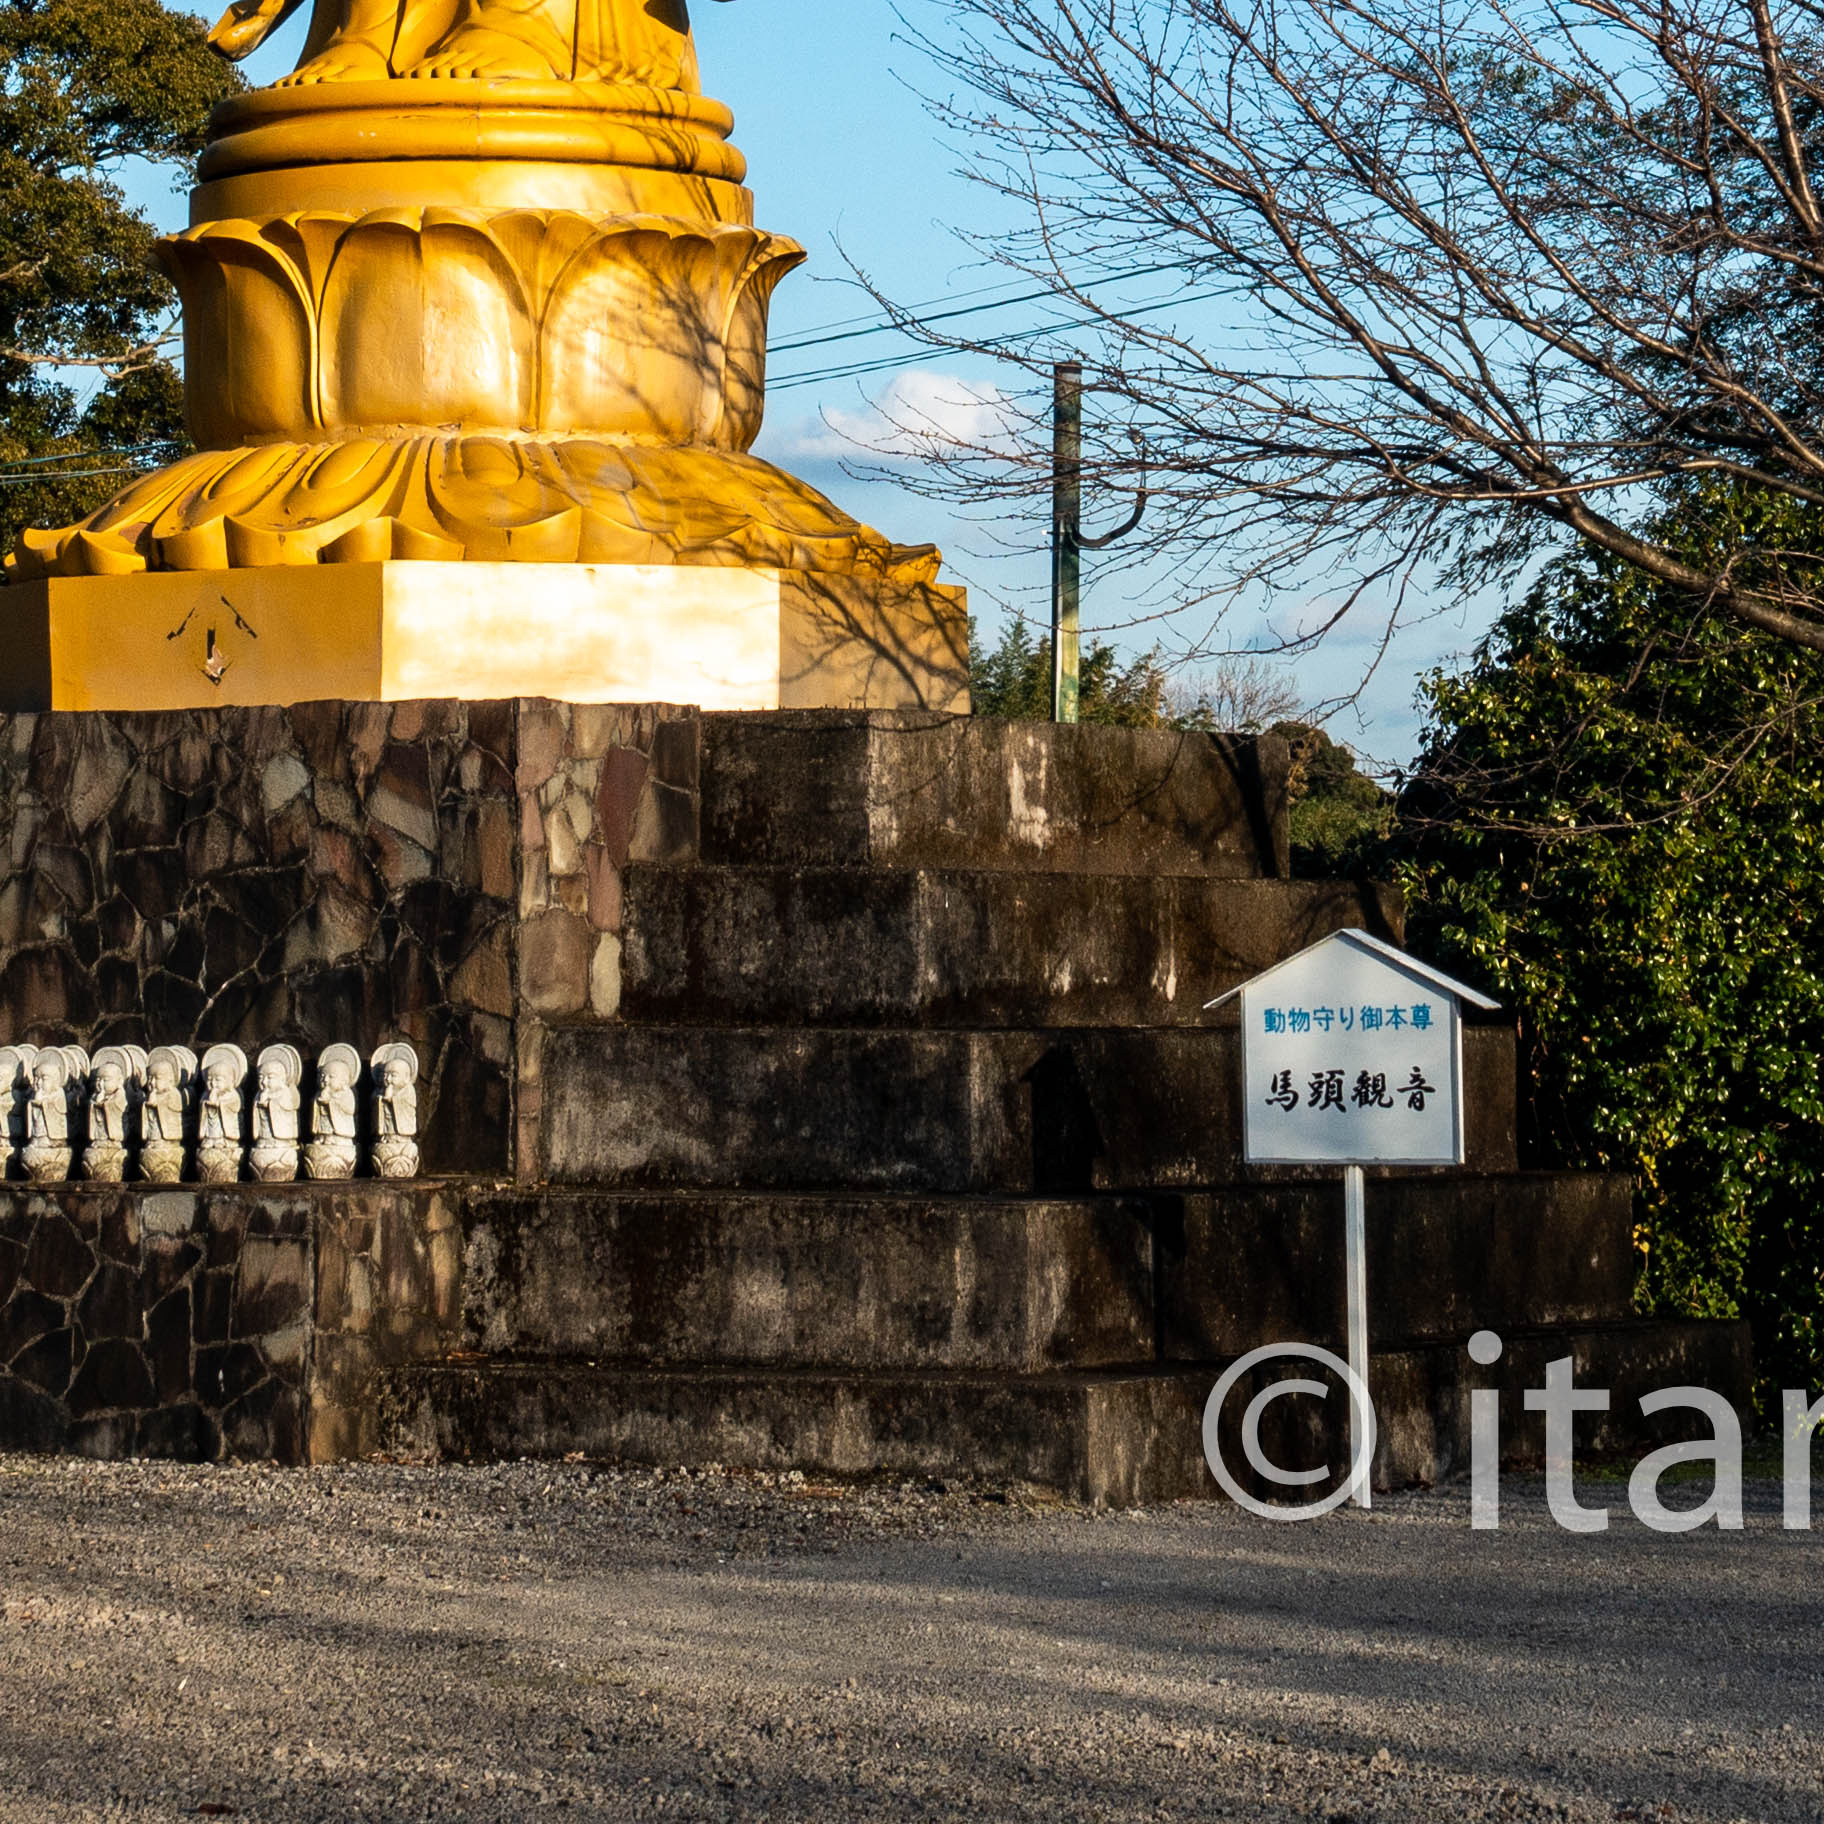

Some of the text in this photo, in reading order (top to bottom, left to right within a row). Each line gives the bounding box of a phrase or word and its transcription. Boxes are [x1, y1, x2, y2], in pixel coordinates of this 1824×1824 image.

[1263, 1002, 1434, 1034] 動物守り御本尊
[1264, 1066, 1436, 1113] 馬頭観音
